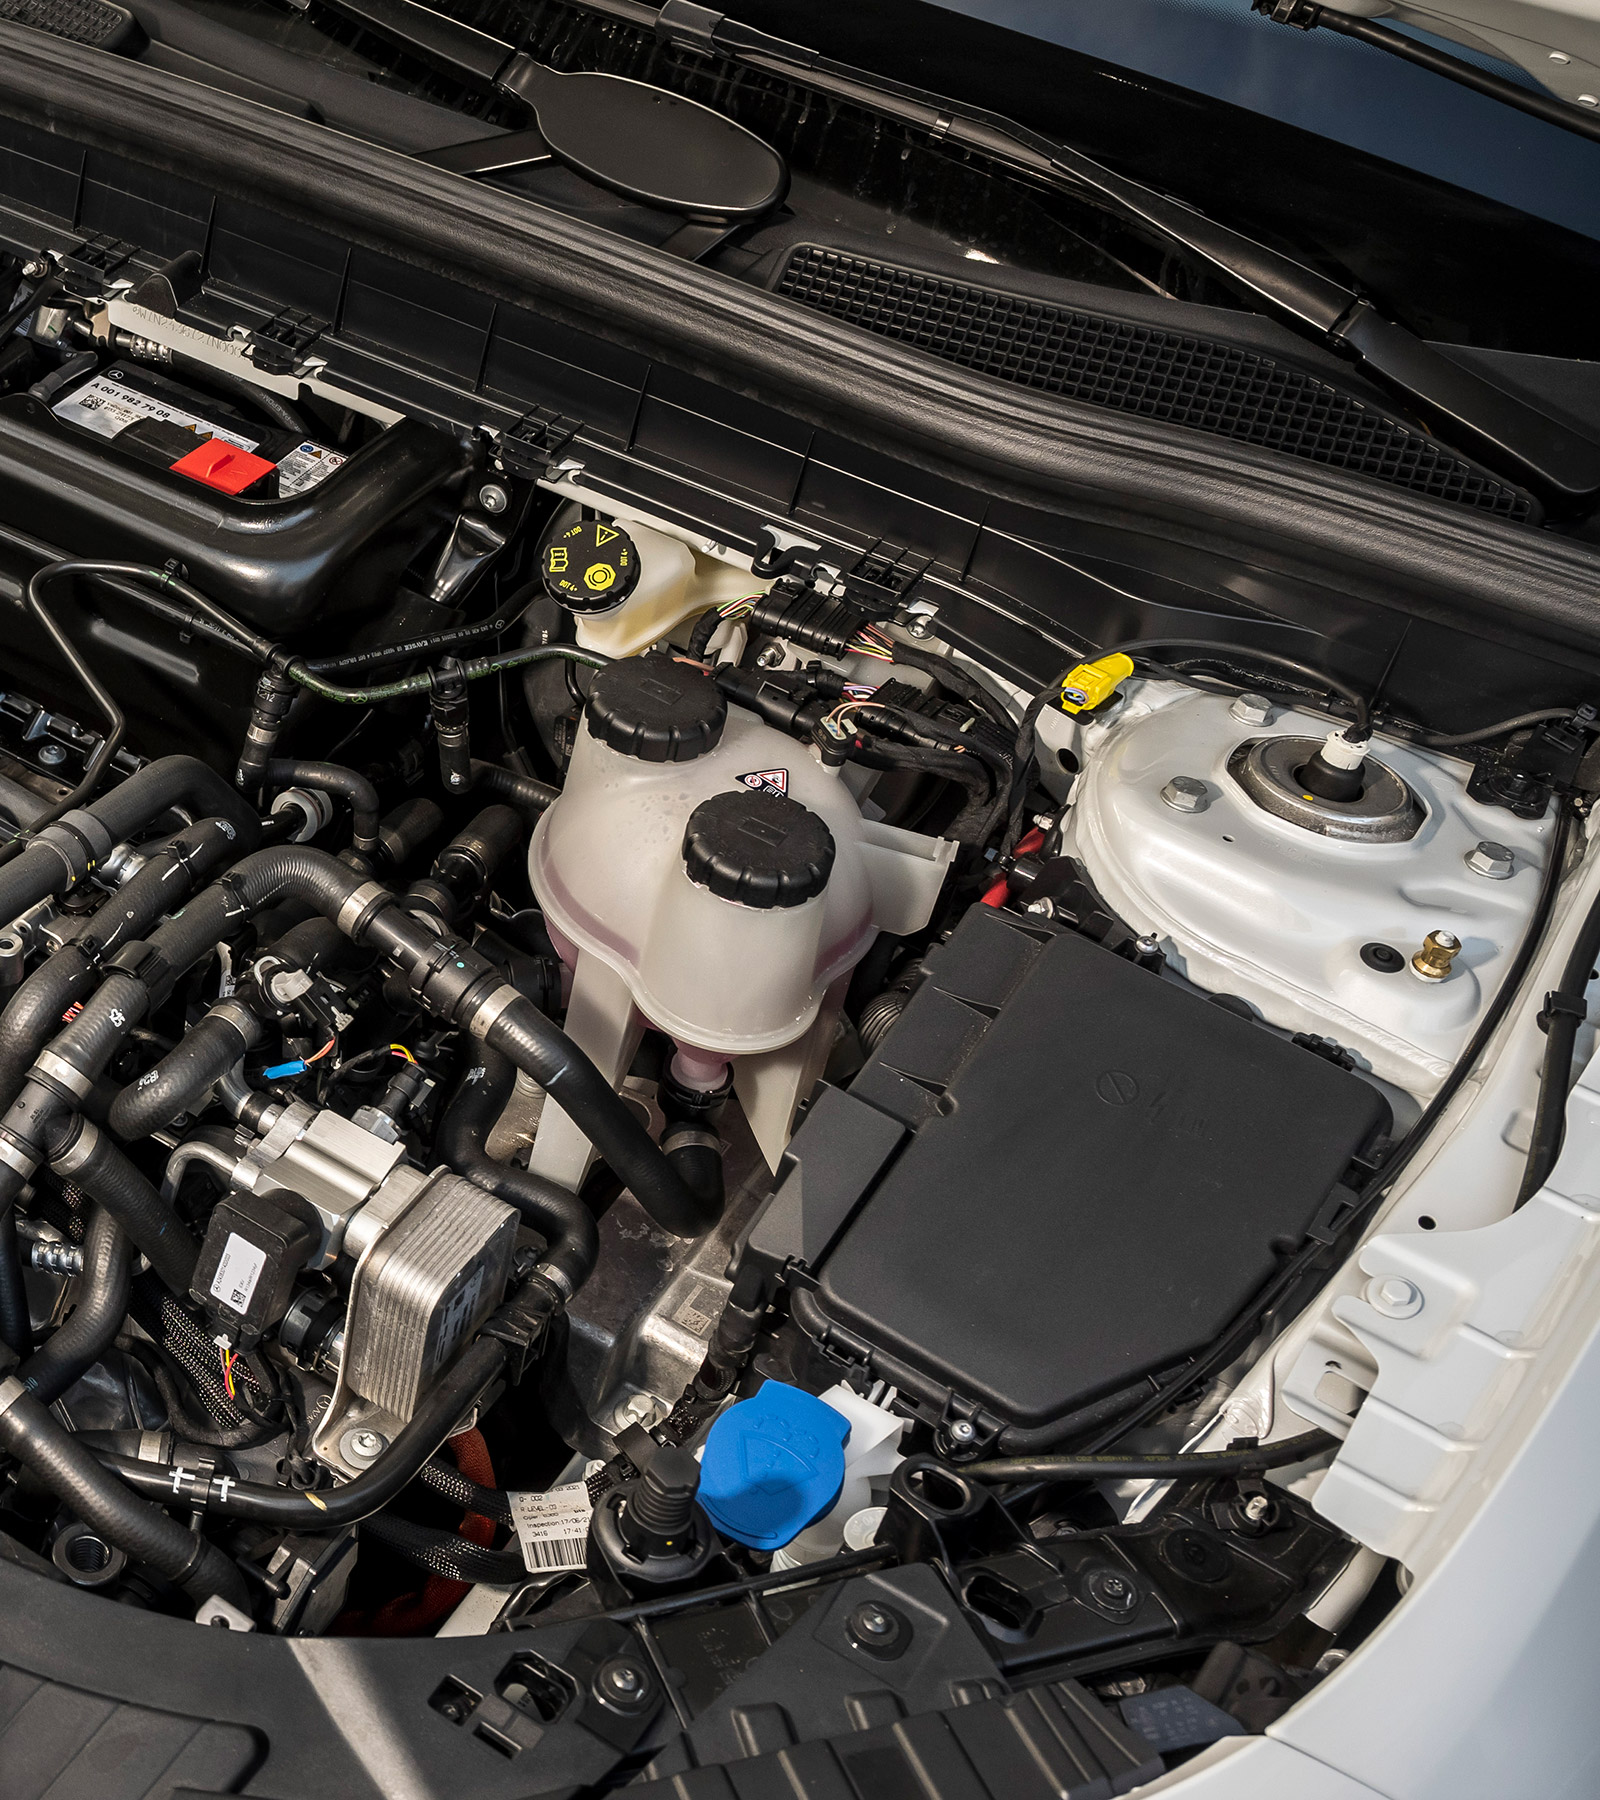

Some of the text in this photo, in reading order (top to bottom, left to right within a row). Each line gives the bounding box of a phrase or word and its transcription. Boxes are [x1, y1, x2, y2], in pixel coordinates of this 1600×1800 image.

[101, 386, 121, 397] 001
[121, 394, 142, 406] 982
[141, 403, 156, 412] 79
[156, 409, 170, 418] 08
[571, 526, 582, 536] DOT
[620, 556, 628, 566] DOT
[559, 580, 571, 589] DOT
[404, 640, 428, 651] KAYSER
